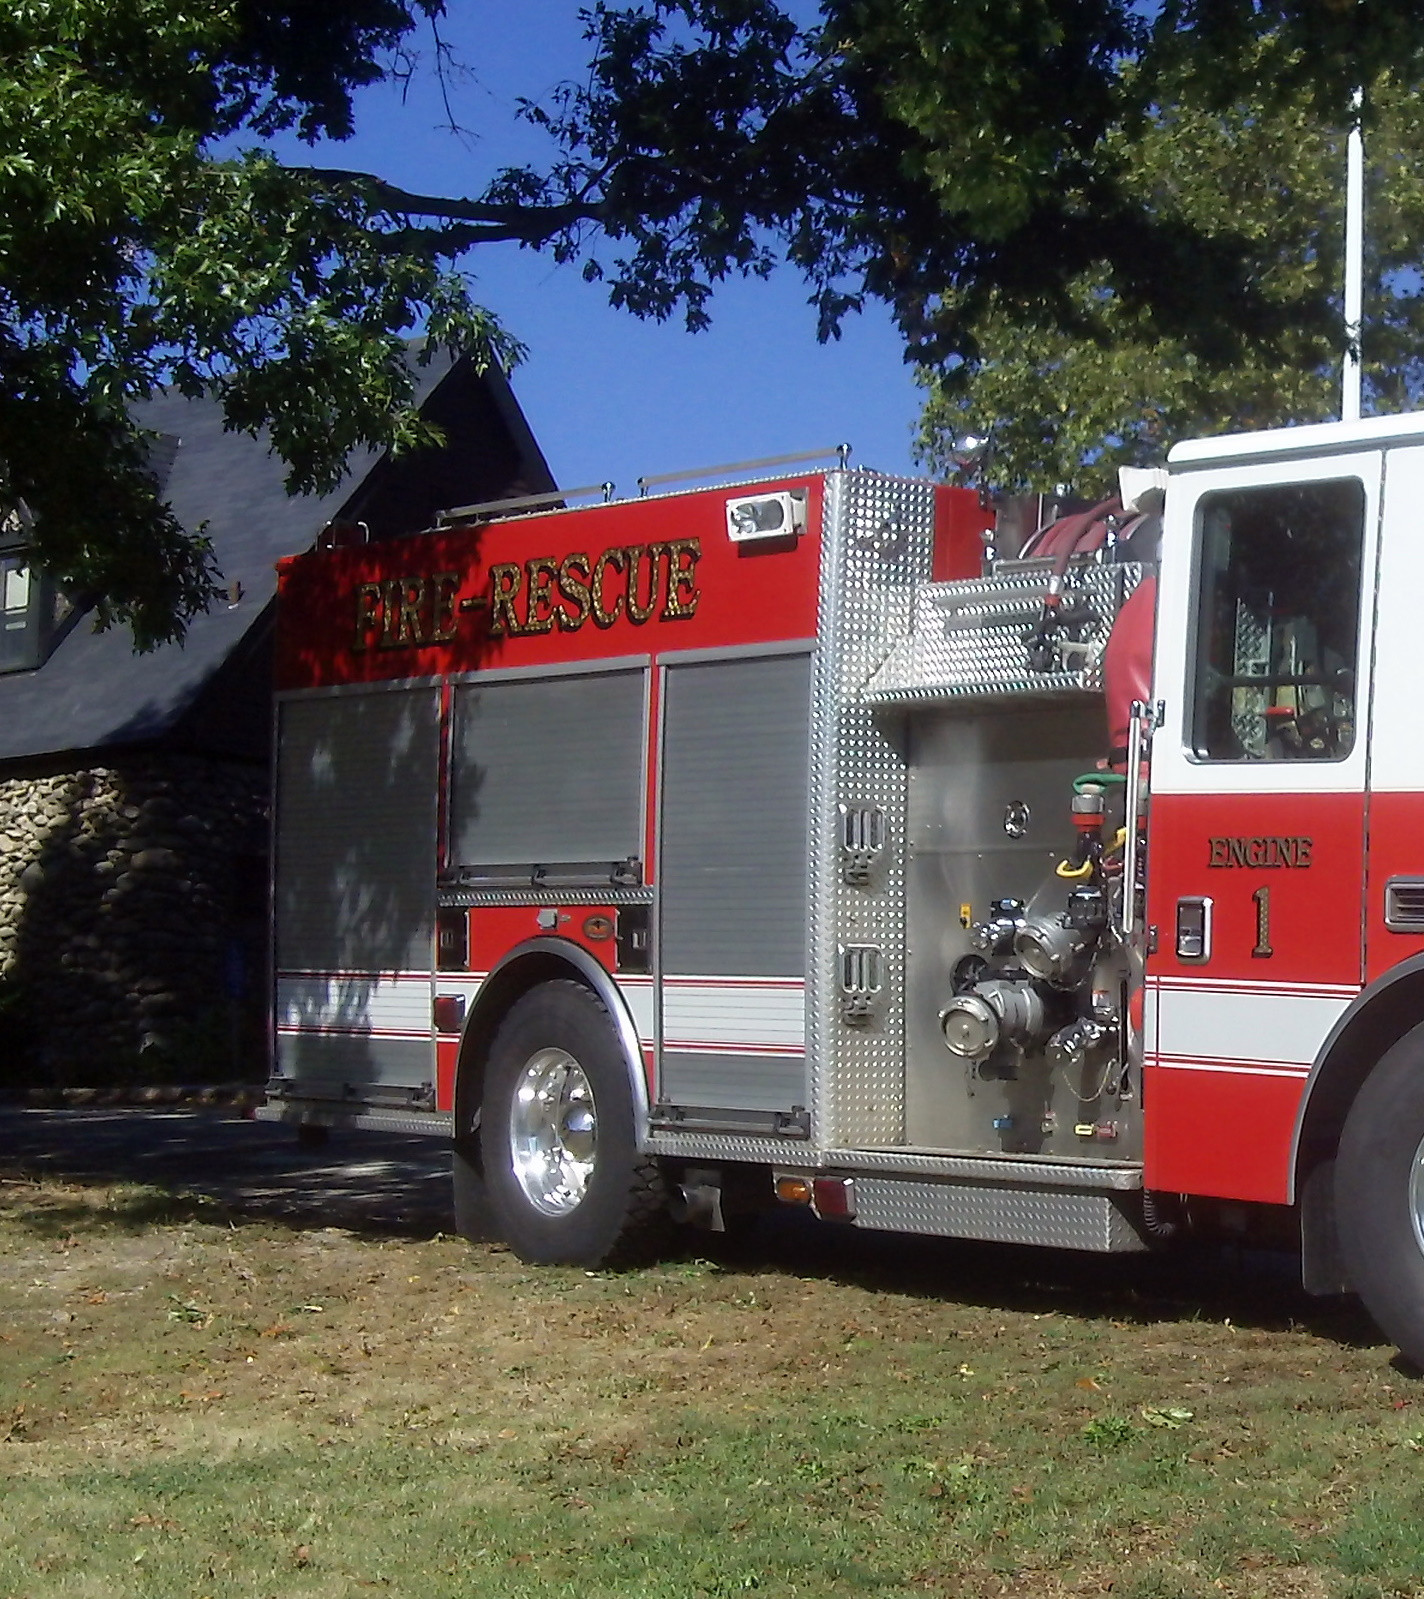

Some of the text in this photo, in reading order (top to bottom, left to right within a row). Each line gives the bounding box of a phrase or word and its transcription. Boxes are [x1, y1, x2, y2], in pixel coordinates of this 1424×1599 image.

[353, 537, 702, 652] FIRE-RESCUE
[1207, 837, 1313, 869] ENGINE
[1251, 886, 1274, 958] 1
